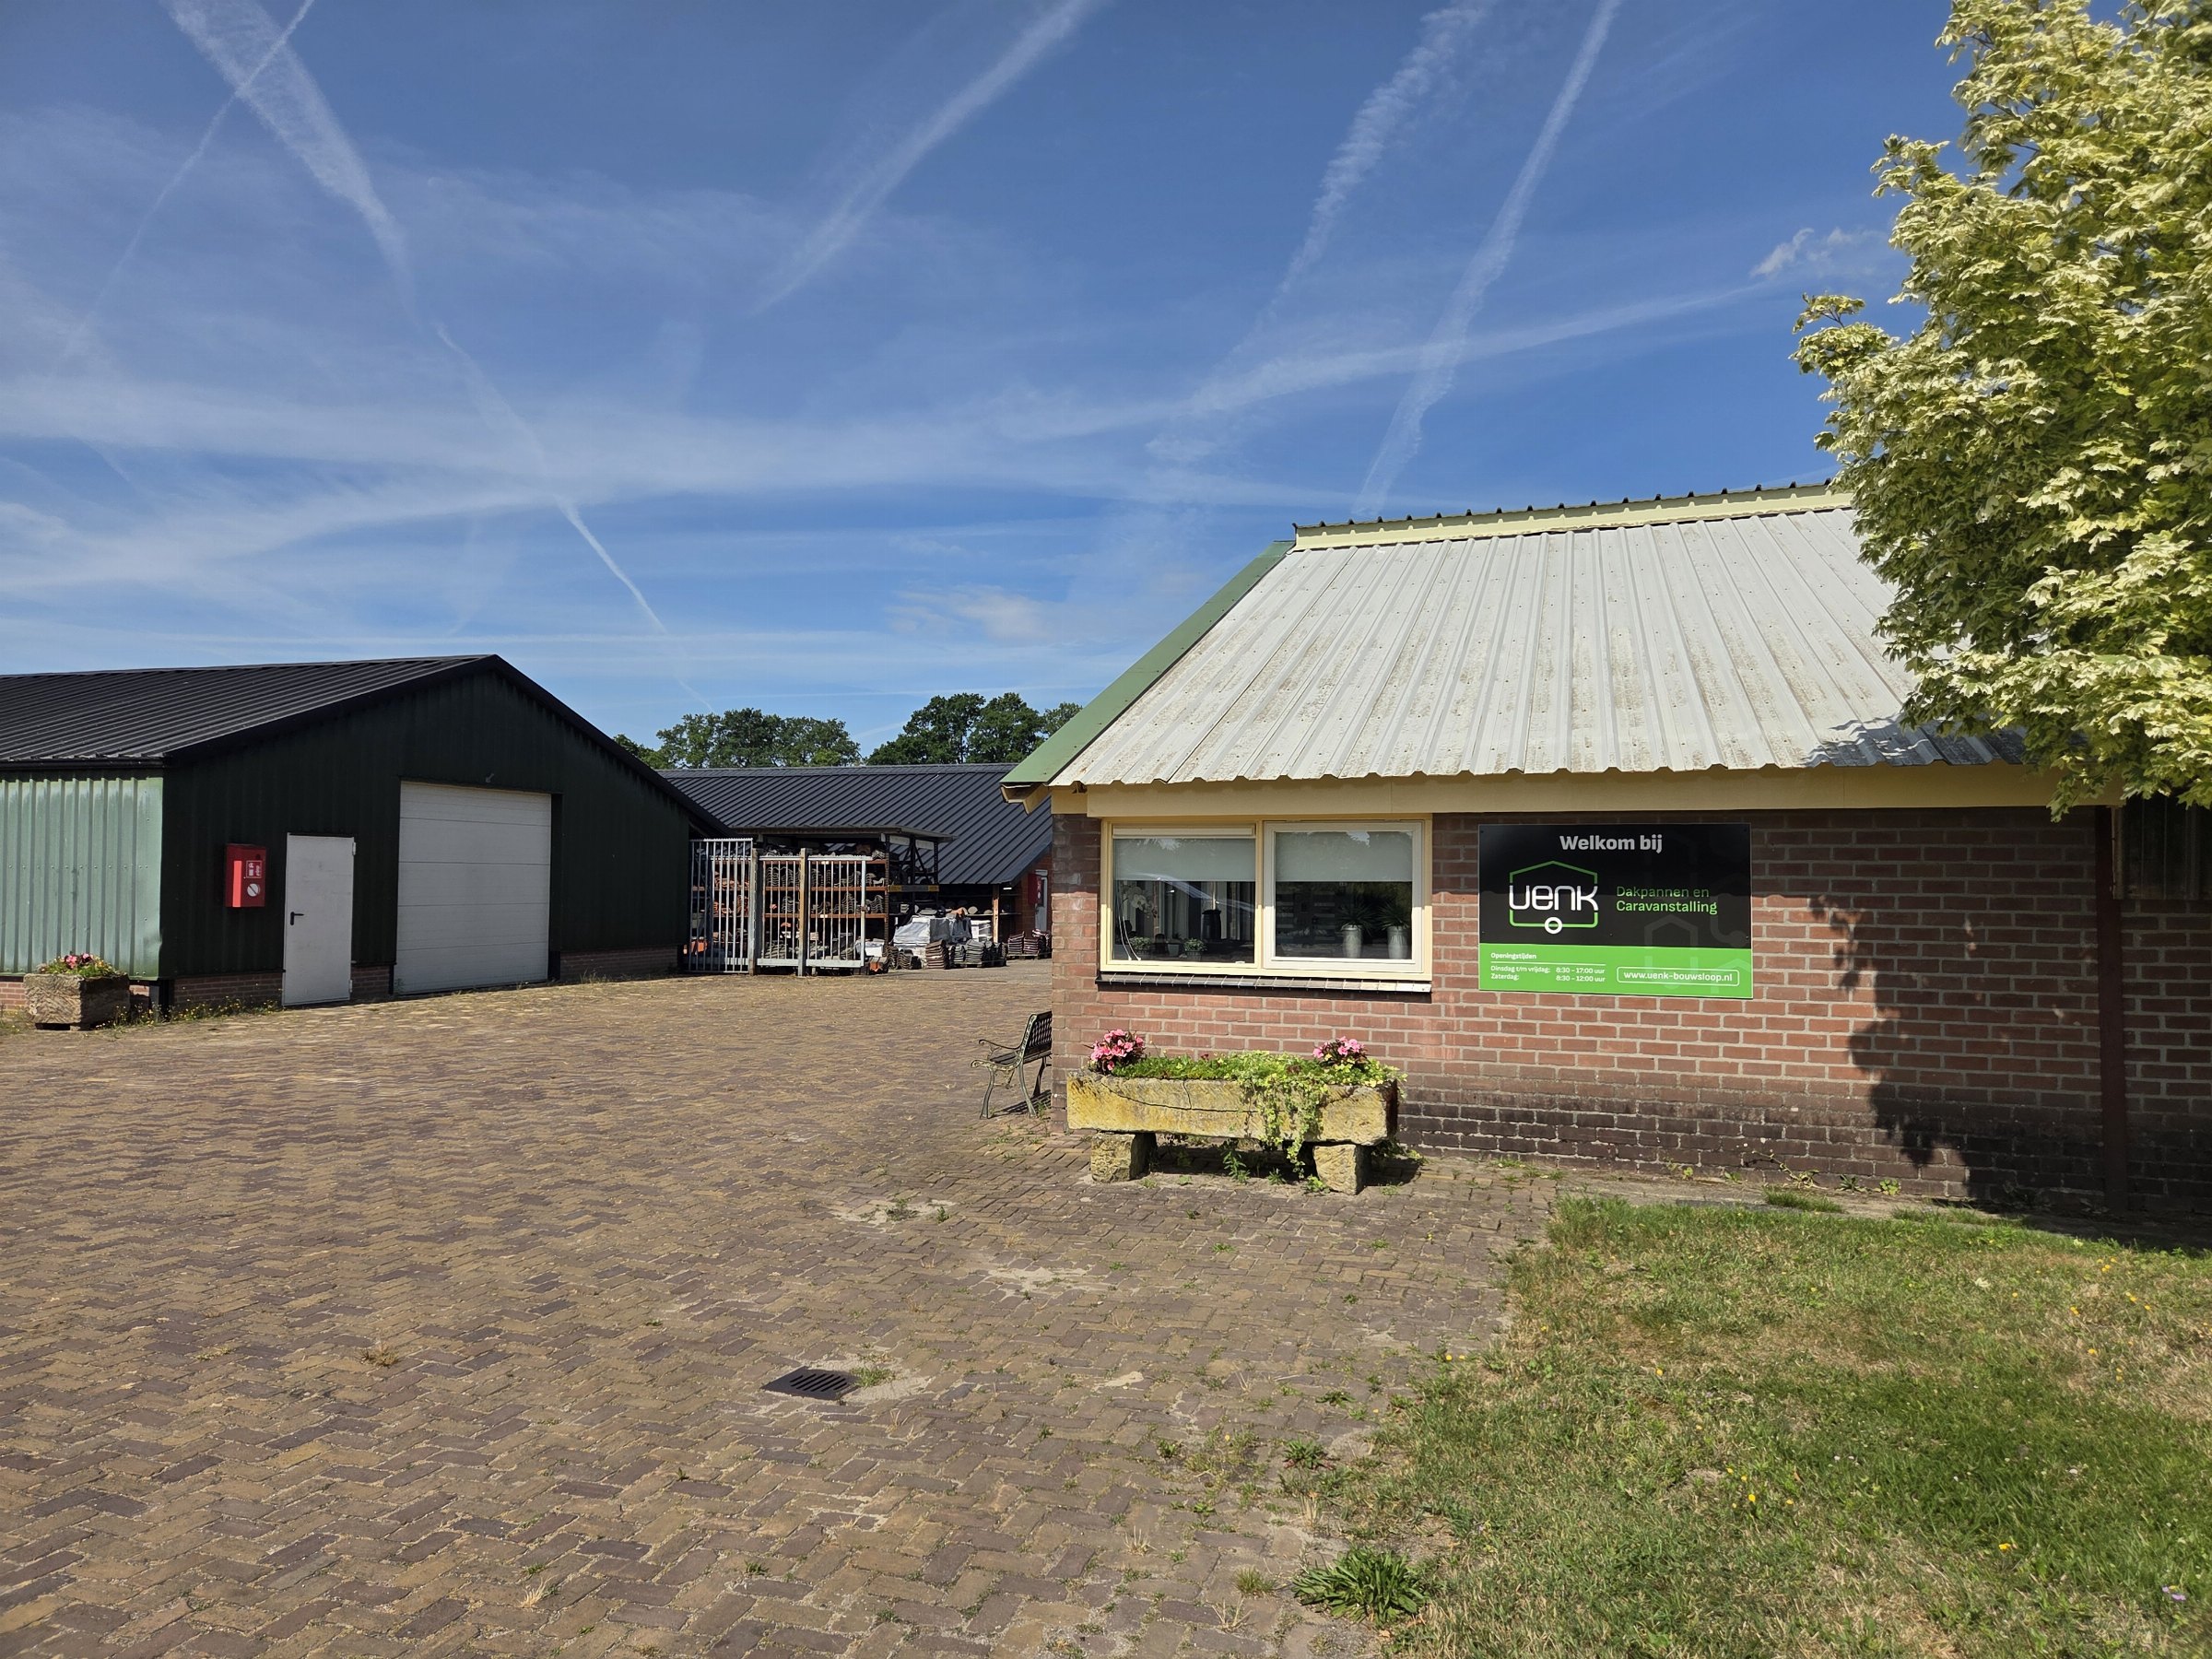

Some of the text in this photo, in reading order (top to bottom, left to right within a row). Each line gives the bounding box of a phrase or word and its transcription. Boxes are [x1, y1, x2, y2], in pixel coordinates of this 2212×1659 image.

[1559, 834, 1663, 854] Welkom bij
[1616, 886, 1710, 900] Dakpannen en
[1616, 900, 1718, 915] Caravanstalling
[1490, 952, 1537, 960] Openingstijden
[1490, 965, 1515, 973] Dinsdag
[1528, 966, 1551, 974] vrijdag:
[1490, 972, 1520, 981] Zaterdag:
[1623, 971, 1733, 983] www.uenk-bouwsloop.nl
